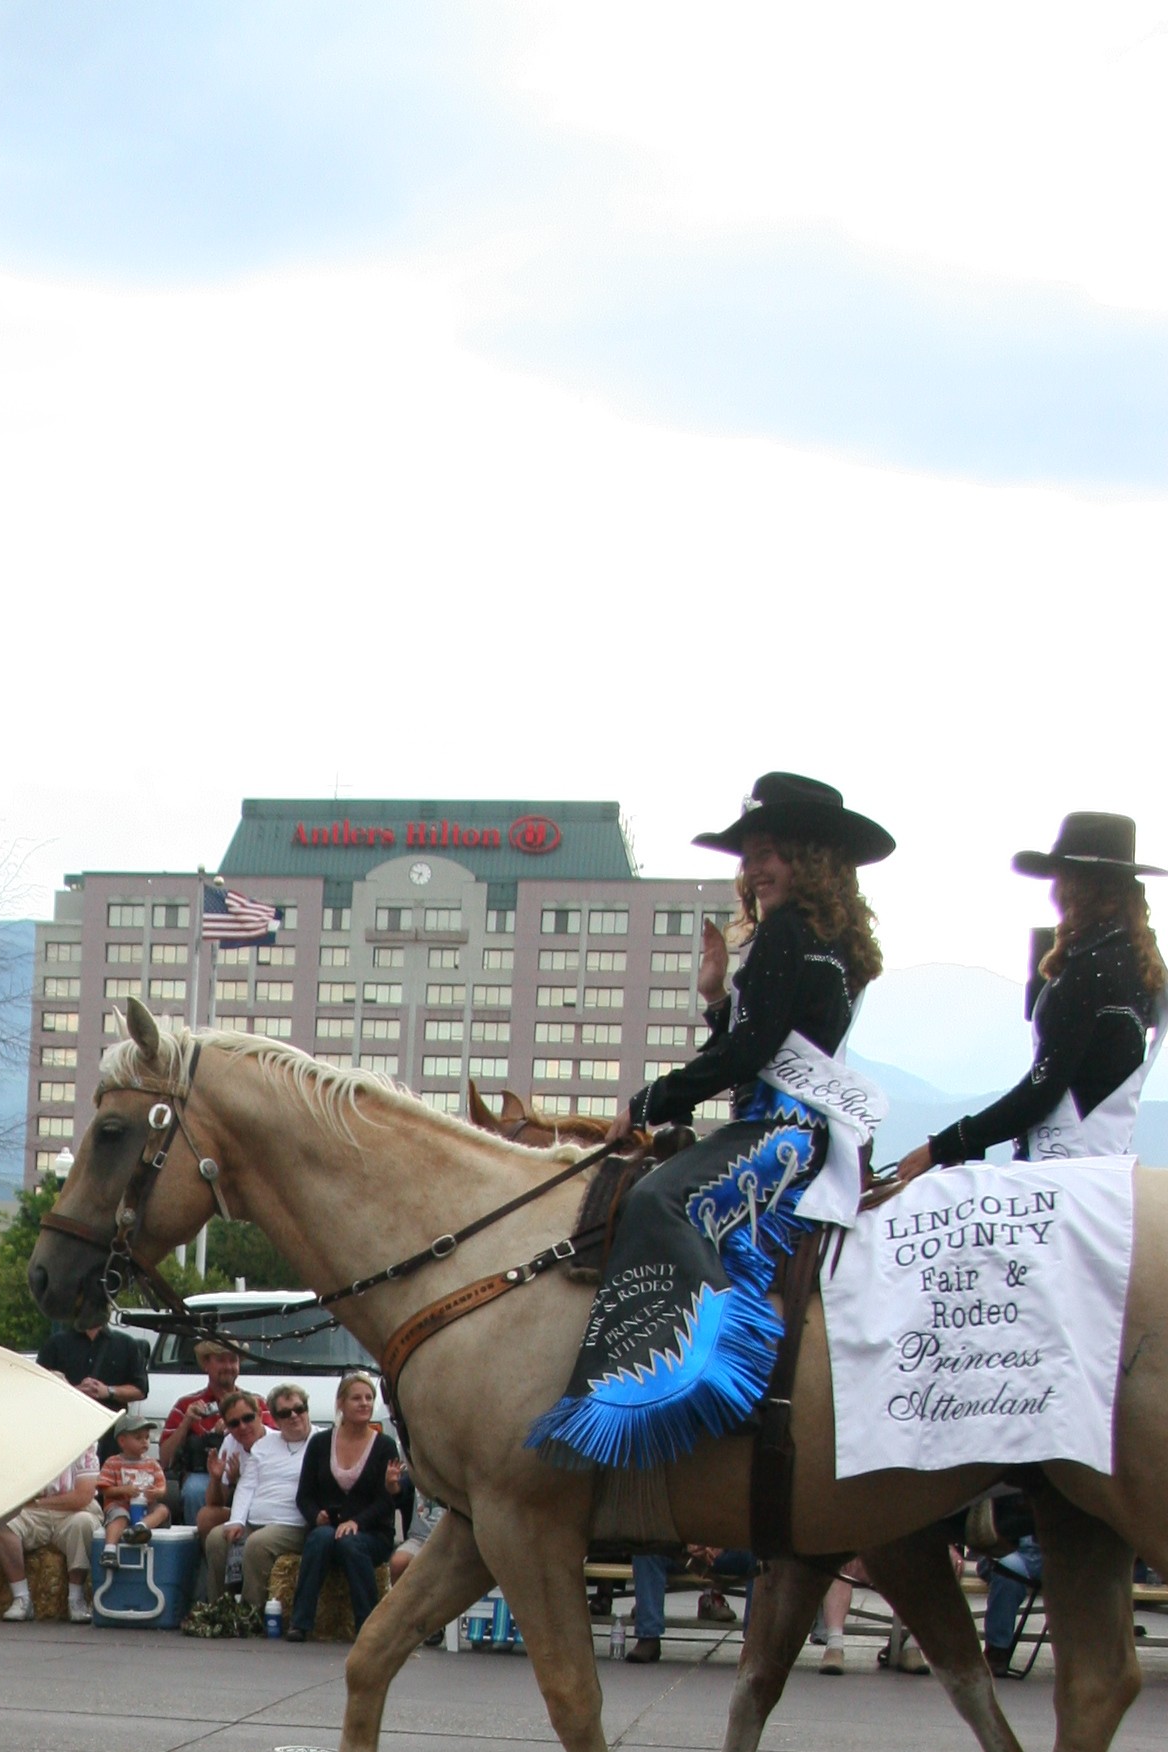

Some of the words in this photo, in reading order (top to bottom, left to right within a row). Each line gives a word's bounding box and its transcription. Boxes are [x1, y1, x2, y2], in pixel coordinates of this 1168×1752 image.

[291, 819, 395, 849] Antlers
[405, 818, 501, 849] Hilton
[765, 1048, 814, 1090] Fair
[885, 1191, 1058, 1240] LINCOLN
[895, 1220, 1054, 1266] COUNTY
[612, 1264, 676, 1286] COUNTY
[921, 1265, 979, 1292] Fair
[1006, 1260, 1028, 1288] &
[585, 1316, 606, 1346] FAIR
[617, 1280, 674, 1301] RODEO
[931, 1300, 1018, 1329] Rodeo
[897, 1331, 1042, 1374] Princess
[888, 1382, 1056, 1422] Attendant
